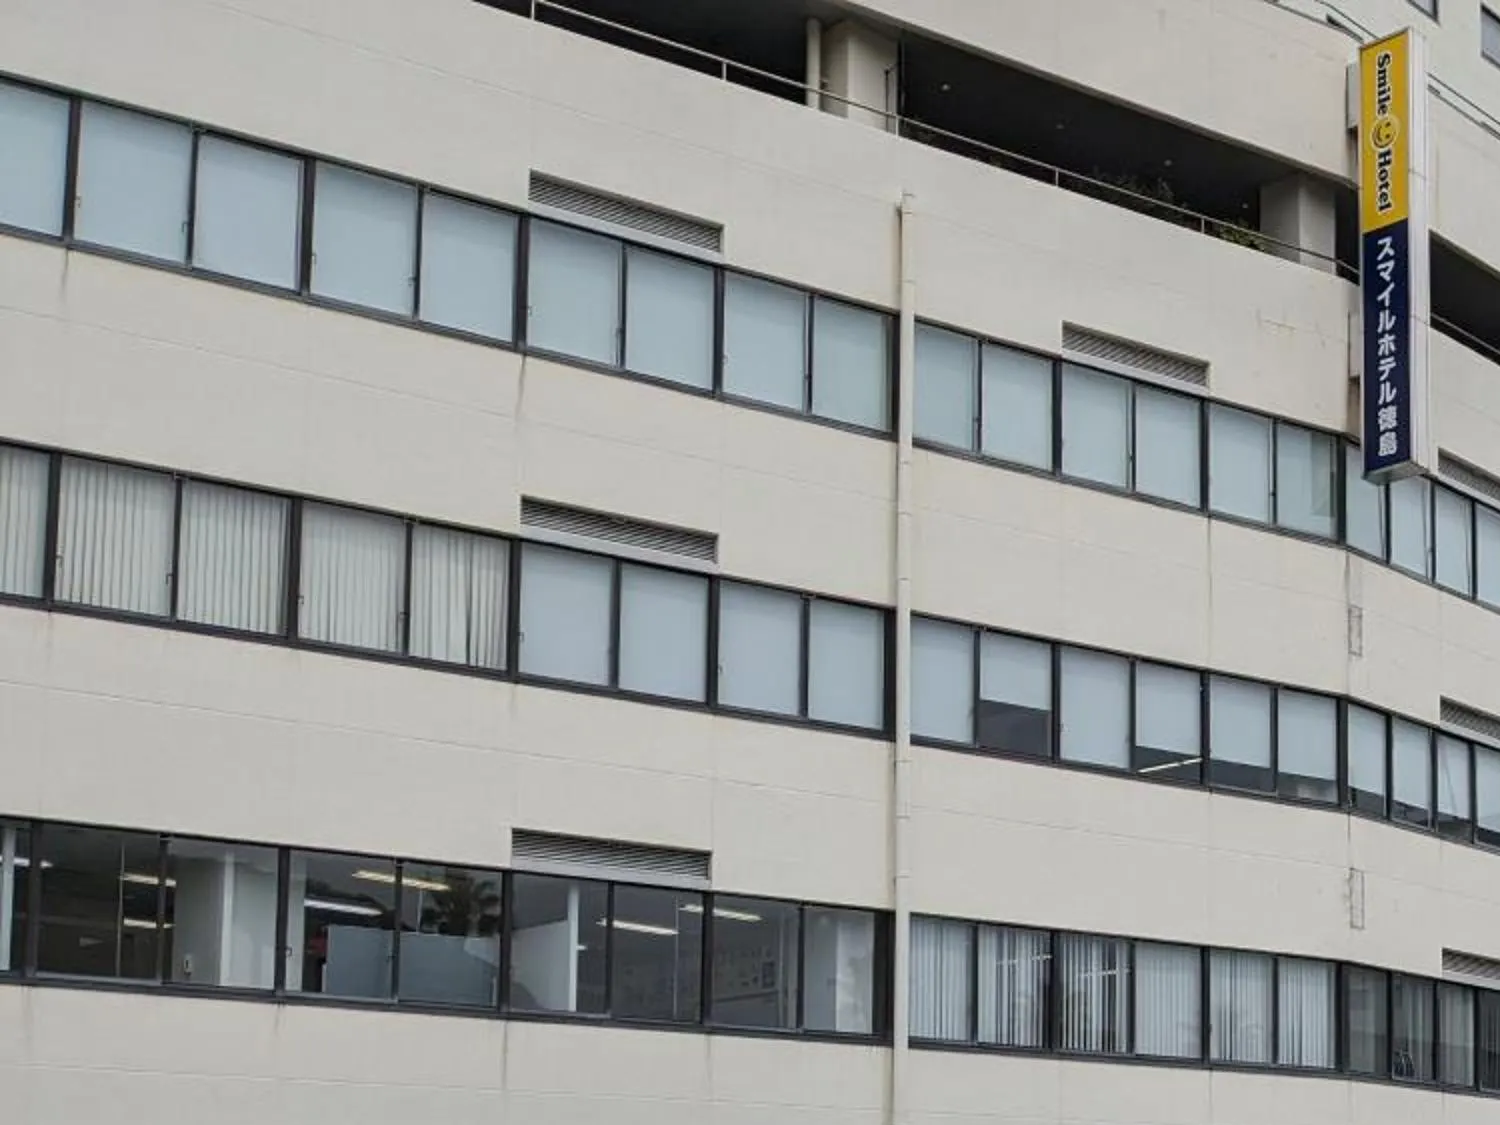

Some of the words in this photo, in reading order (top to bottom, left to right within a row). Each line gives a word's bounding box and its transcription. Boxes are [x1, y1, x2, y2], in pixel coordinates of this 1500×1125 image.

[1377, 53, 1391, 115] Smile
[1378, 149, 1392, 212] Hotel
[1377, 236, 1397, 456] スマイルホテル徳島
